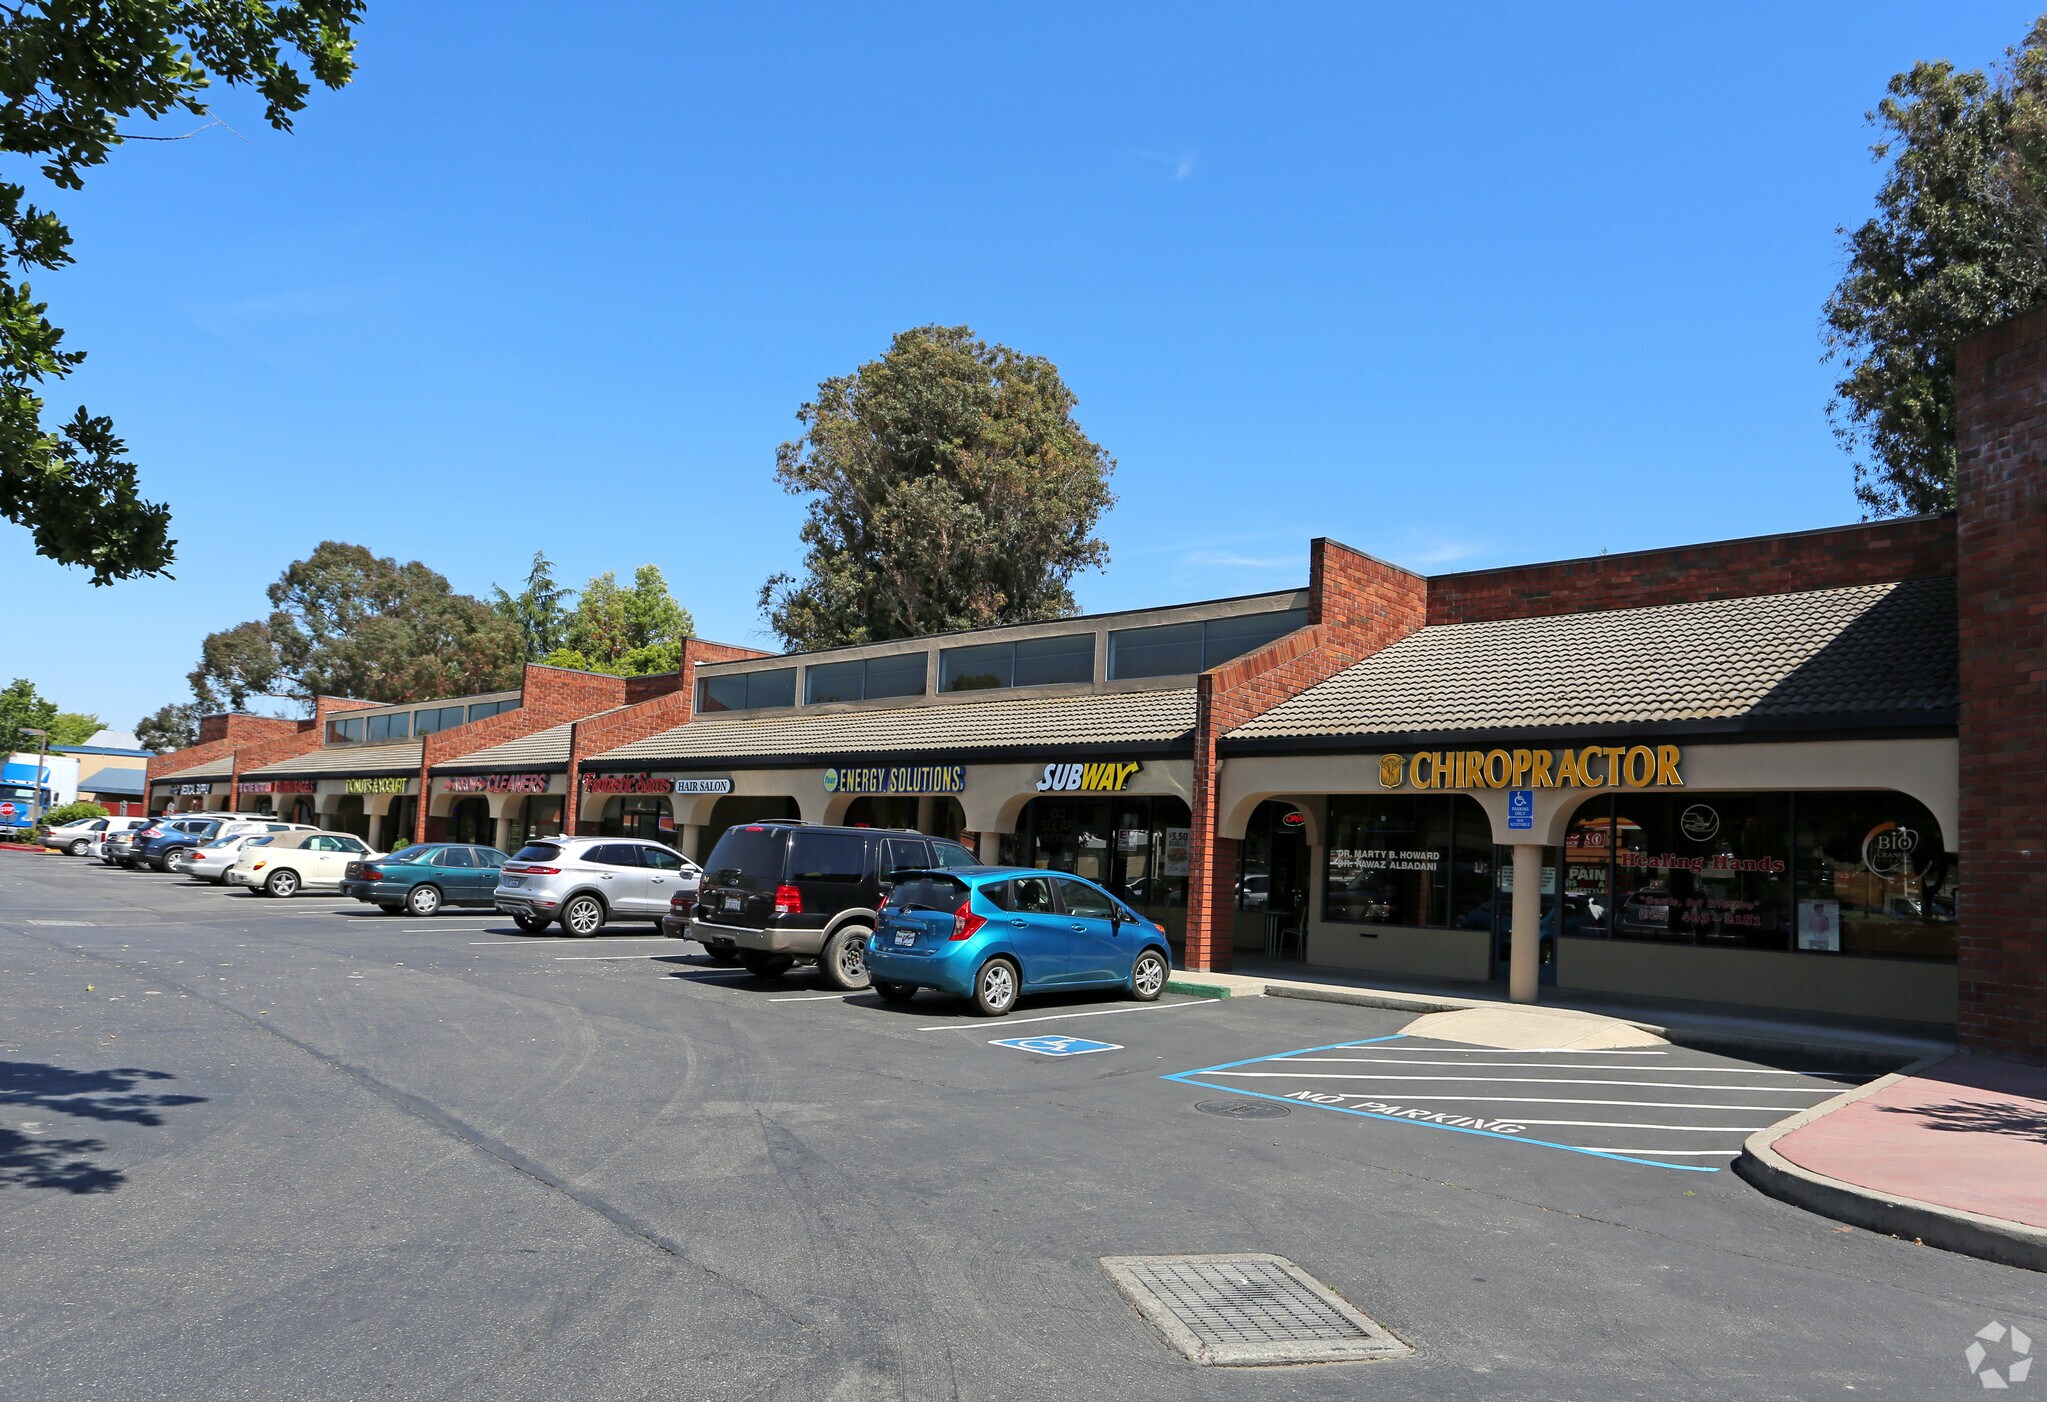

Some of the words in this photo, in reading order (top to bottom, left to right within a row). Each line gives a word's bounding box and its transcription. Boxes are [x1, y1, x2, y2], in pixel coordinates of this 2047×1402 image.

[1036, 761, 1140, 792] SUBWAY
[1409, 745, 1684, 789] CHIROPRACTOR
[345, 779, 372, 794] DONUTS
[379, 777, 408, 794] YOGURT
[486, 774, 546, 793] CLEANERS
[582, 773, 635, 793] Fantastic
[635, 772, 671, 793] Sams
[678, 781, 698, 792] HAIR
[699, 781, 727, 792] SALON
[840, 768, 885, 792] ENERGY
[890, 766, 961, 792] SOLUTIONS
[1168, 832, 1188, 841] $3.50
[1337, 850, 1353, 858] DR.
[1354, 850, 1387, 859] MARTY
[1389, 851, 1398, 859] B.
[1400, 851, 1440, 860] HOWARD
[1620, 853, 1704, 874] Healing
[1712, 855, 1786, 872] Hands
[1337, 860, 1353, 868] DR.
[1389, 861, 1437, 871] ALBADANI
[1568, 868, 1606, 880] PAIN
[1283, 1090, 1346, 1104] NO
[1349, 1101, 1527, 1134] PARKING
